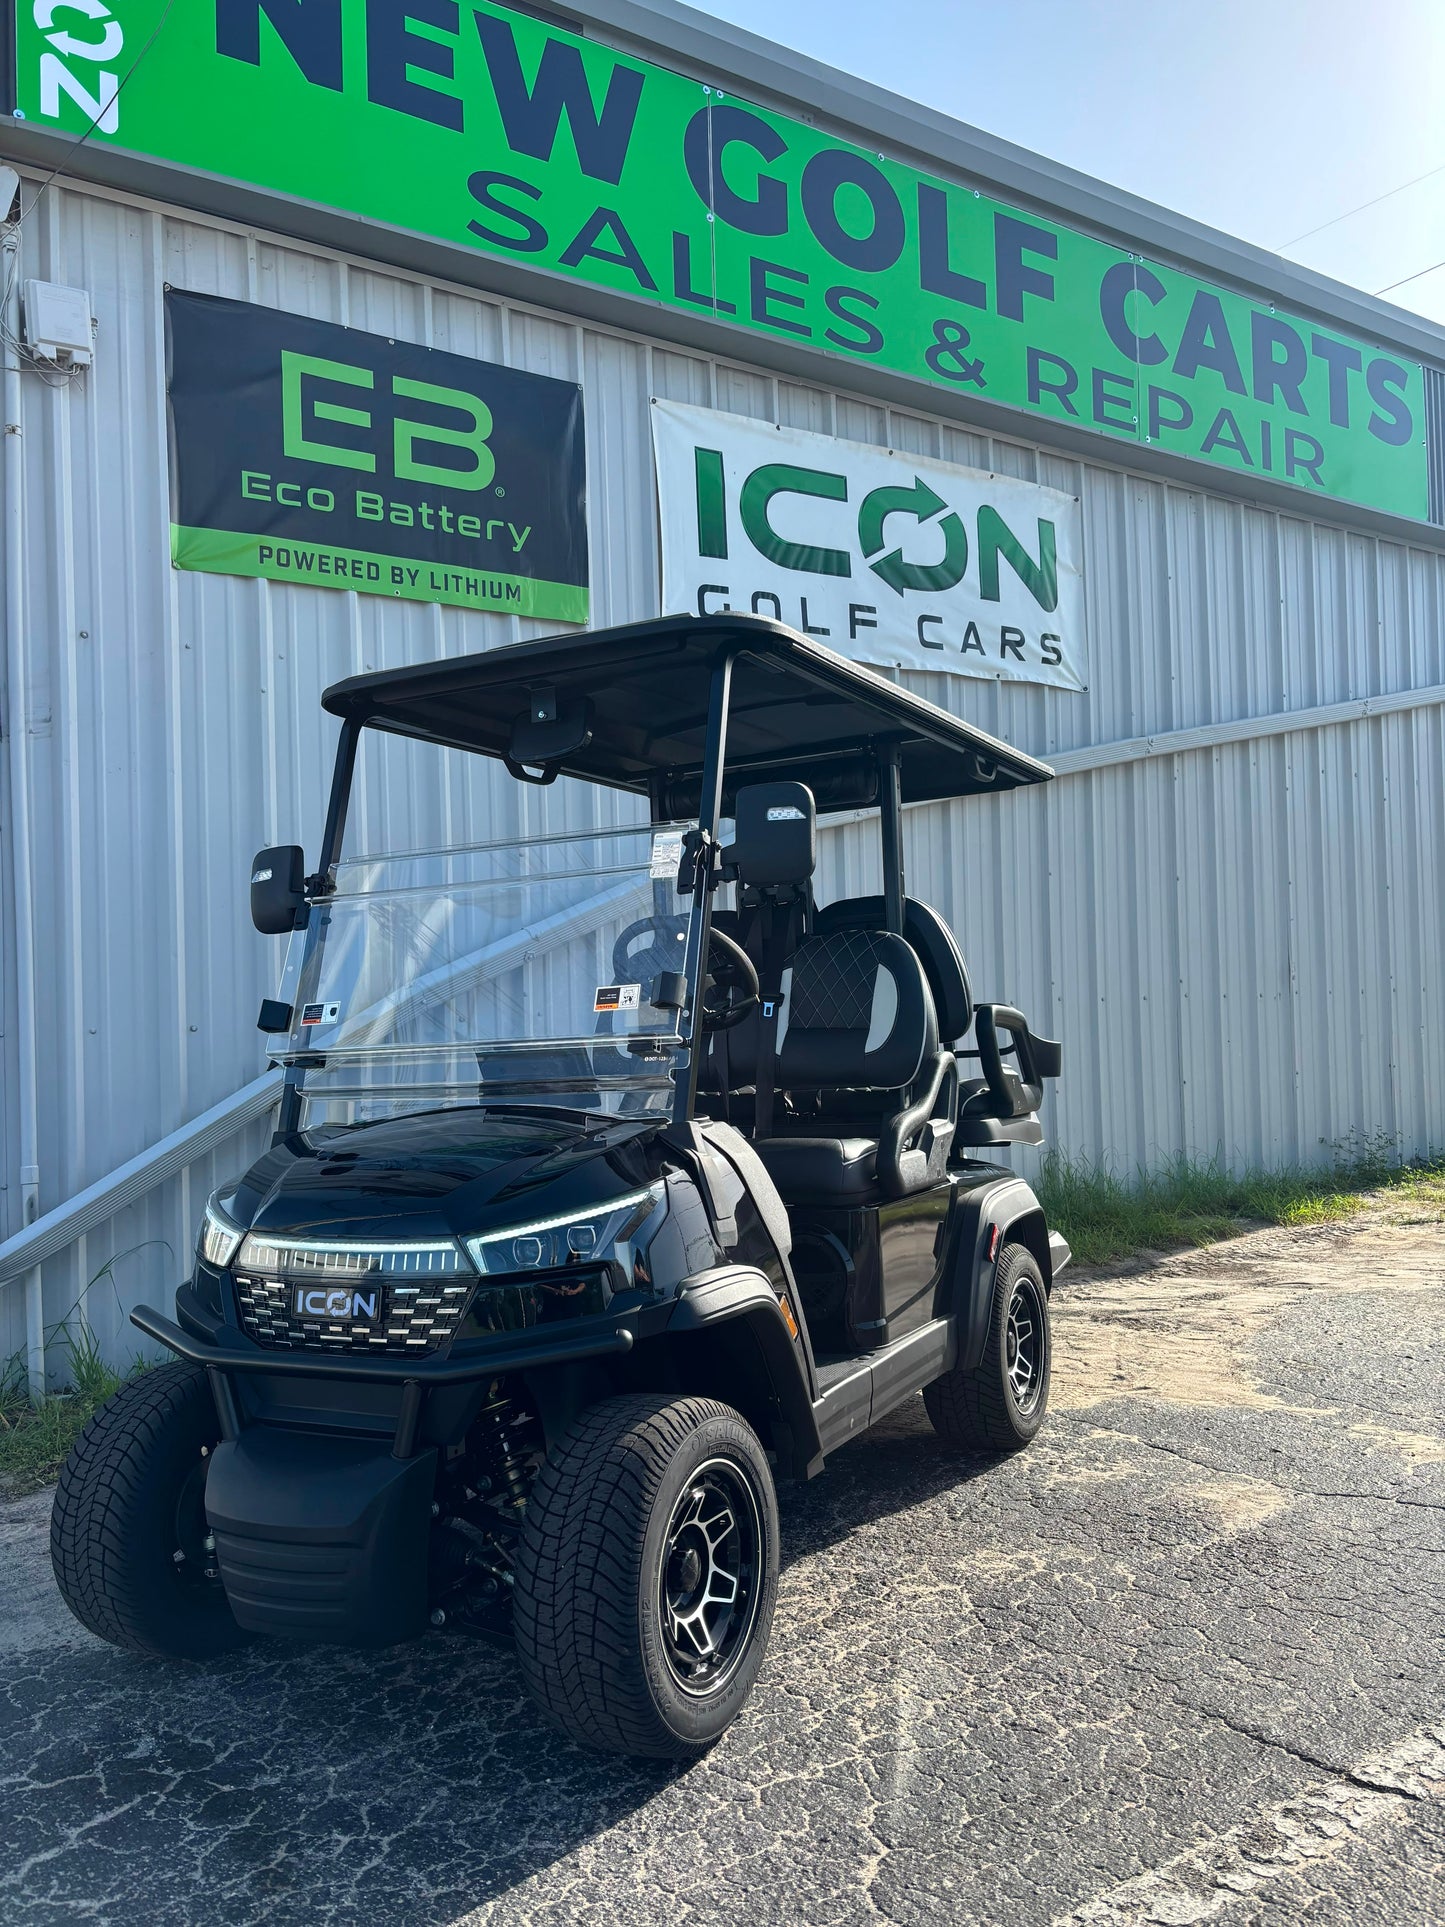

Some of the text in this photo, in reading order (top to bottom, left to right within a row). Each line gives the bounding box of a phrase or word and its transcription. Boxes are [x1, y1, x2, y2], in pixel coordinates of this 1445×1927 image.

[216, 0, 1413, 446] NEW GOLF CARTS
[466, 170, 1326, 487] SALES & REPAIR
[281, 350, 496, 491] EB
[241, 470, 532, 552] Eco Battery
[694, 446, 1060, 614] ICON
[259, 545, 521, 602] POWERED BY LITHIUM
[917, 614, 1062, 665] CARS
[297, 1290, 376, 1318] ICON
